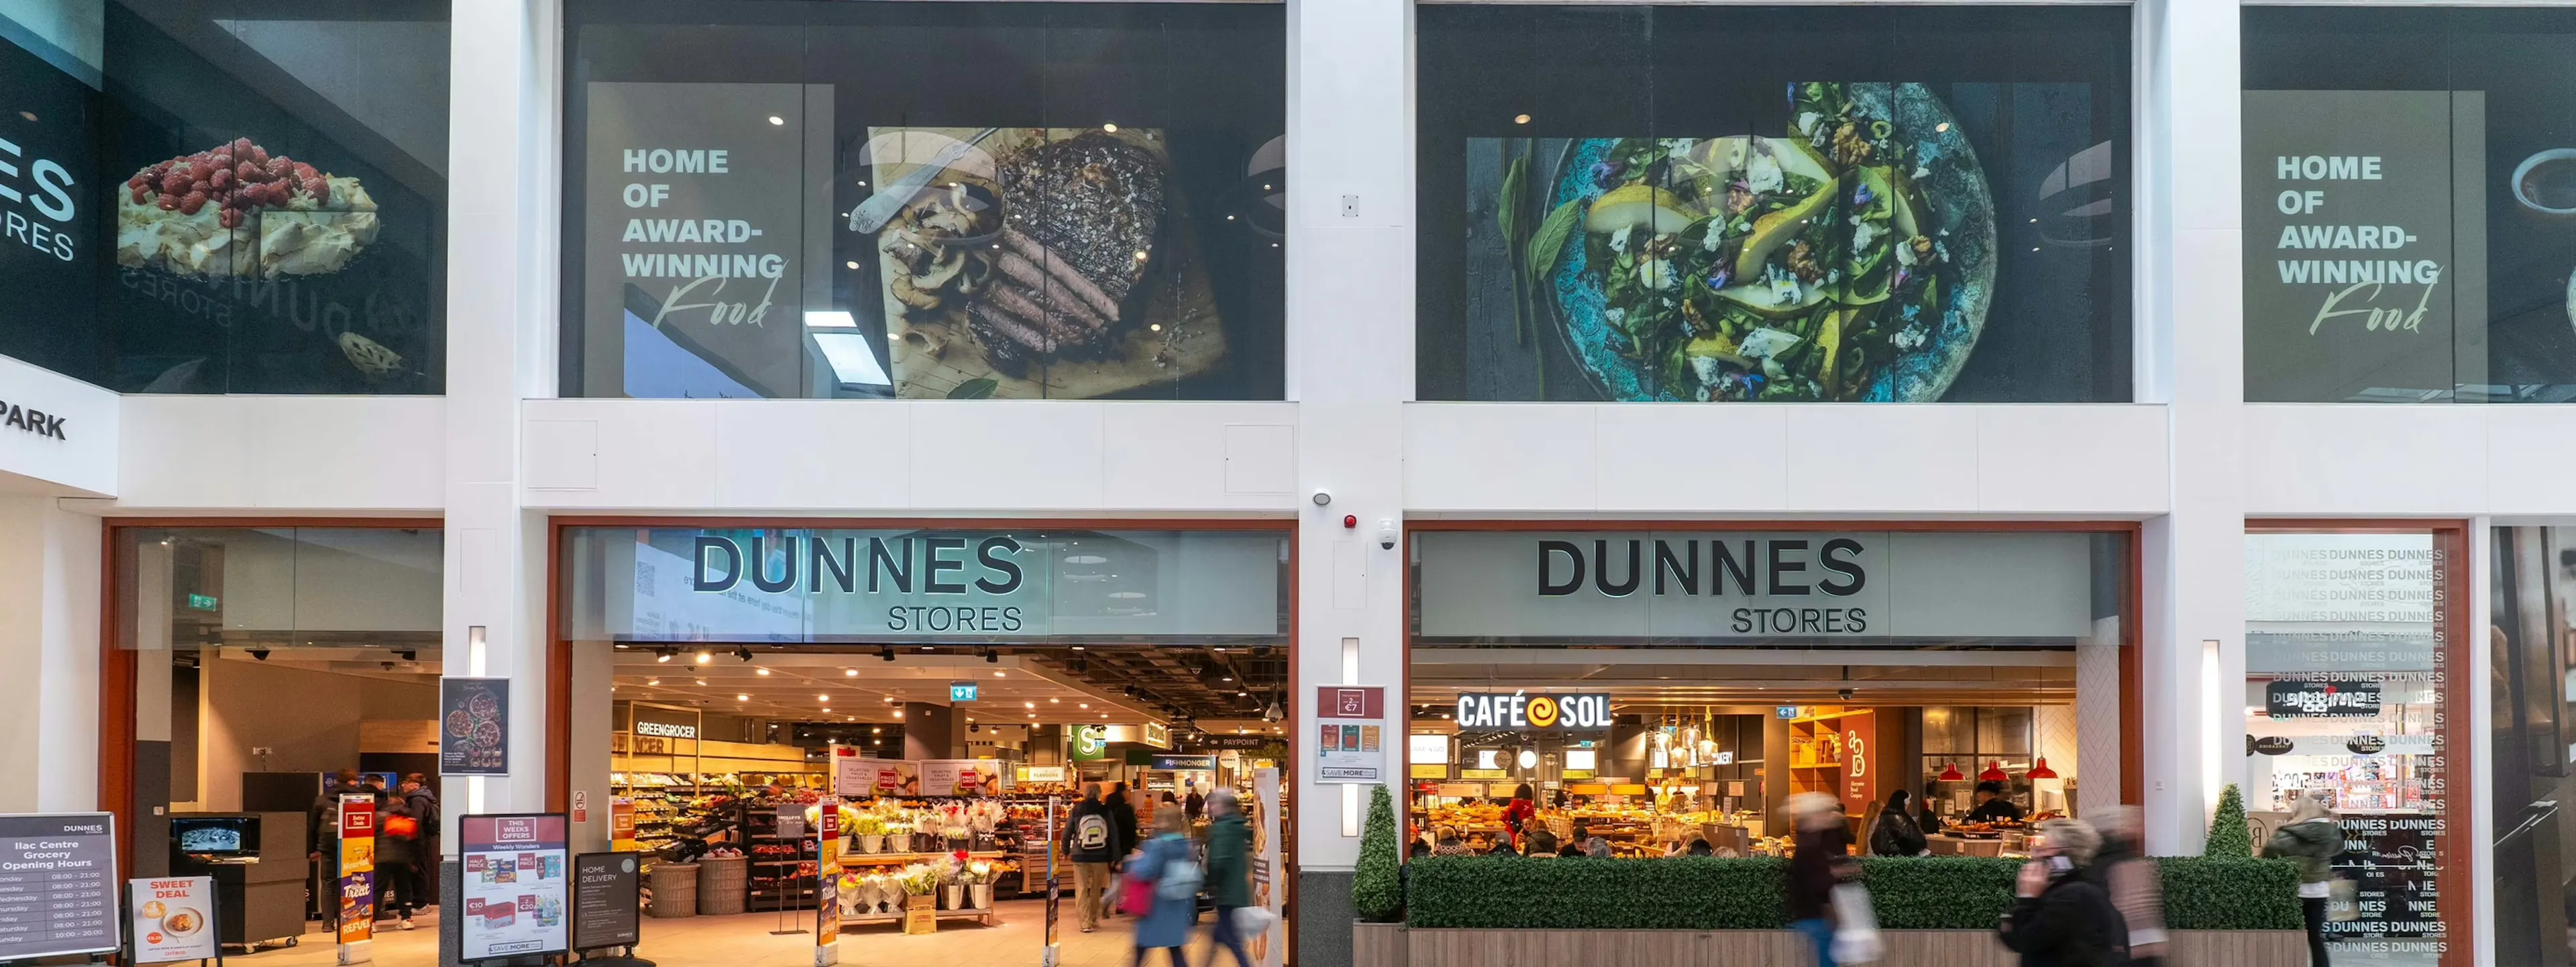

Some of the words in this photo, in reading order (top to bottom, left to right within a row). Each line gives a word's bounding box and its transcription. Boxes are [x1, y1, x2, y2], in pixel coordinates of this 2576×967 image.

[624, 149, 729, 173] HOME
[2277, 156, 2382, 180] HOME
[623, 183, 669, 208] OF
[2277, 191, 2324, 215] OF
[622, 219, 762, 243] AWARD-
[2277, 225, 2416, 249] AWARD-
[622, 254, 784, 278] WINNING
[2277, 260, 2438, 285] WINNING
[652, 258, 790, 329] Food
[2309, 264, 2445, 336] Food
[2330, 550, 2384, 560] DUNNES
[2388, 550, 2443, 560] DUNNES
[694, 536, 1024, 596] DUNNES
[1538, 538, 1866, 597] DUNNES
[2330, 570, 2384, 580] DUNNES
[2388, 570, 2443, 580] DUNNES
[2330, 591, 2384, 600] DUNNES
[2389, 591, 2443, 600] DUNNES
[888, 605, 1023, 633] STORES
[1731, 607, 1866, 634] STORES
[2330, 611, 2384, 621] DUNNES
[2389, 611, 2443, 621] DUNNES
[2330, 652, 2385, 662] DUNNES
[2389, 652, 2444, 662] DUNNES
[2274, 672, 2328, 682] DUNNES
[2331, 672, 2385, 682] DUNNES
[2390, 672, 2444, 682] DUNNES
[1345, 703, 1357, 711] €7
[1458, 689, 1526, 727] CAFÉ
[1560, 696, 1611, 727] SOL
[637, 721, 695, 738] GREENGROCER
[2390, 735, 2445, 745] DUNNES
[2391, 819, 2446, 829] DUNNES
[23, 852, 70, 860] Grocery
[3, 861, 54, 870] Opening
[150, 880, 194, 889] SWEET
[582, 874, 618, 883] DELIVERY
[156, 890, 190, 899] DEAL
[343, 883, 370, 898] Treat
[343, 920, 371, 934] REFUEL
[2333, 921, 2387, 932] DUNNES
[2392, 921, 2447, 932] DUNNES
[2333, 942, 2388, 952] DUNNES
[2392, 942, 2447, 952] DUNNES
